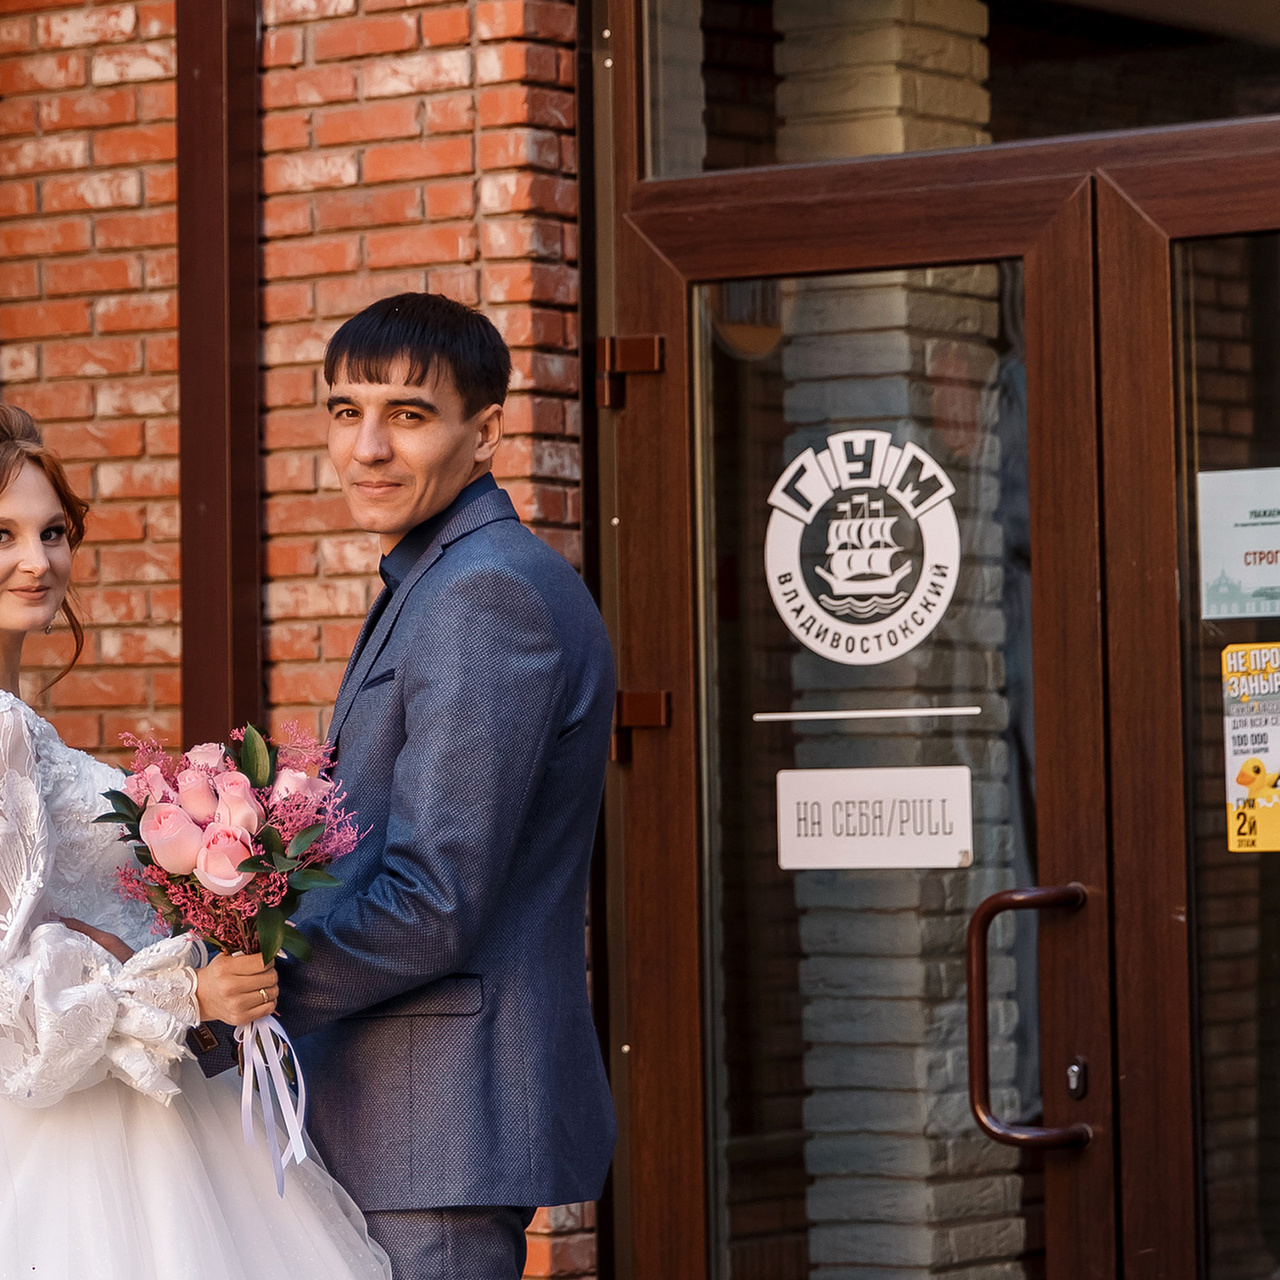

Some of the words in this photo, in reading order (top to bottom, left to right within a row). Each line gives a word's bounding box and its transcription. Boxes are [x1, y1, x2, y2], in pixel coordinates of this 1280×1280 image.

[782, 439, 944, 512] ГУМ
[777, 564, 950, 654] ВЛАДИВОСТОКСКИЙ
[1227, 650, 1247, 673] НЕ
[796, 800, 823, 838] НА
[832, 798, 954, 838] СЕБЯ/PULL
